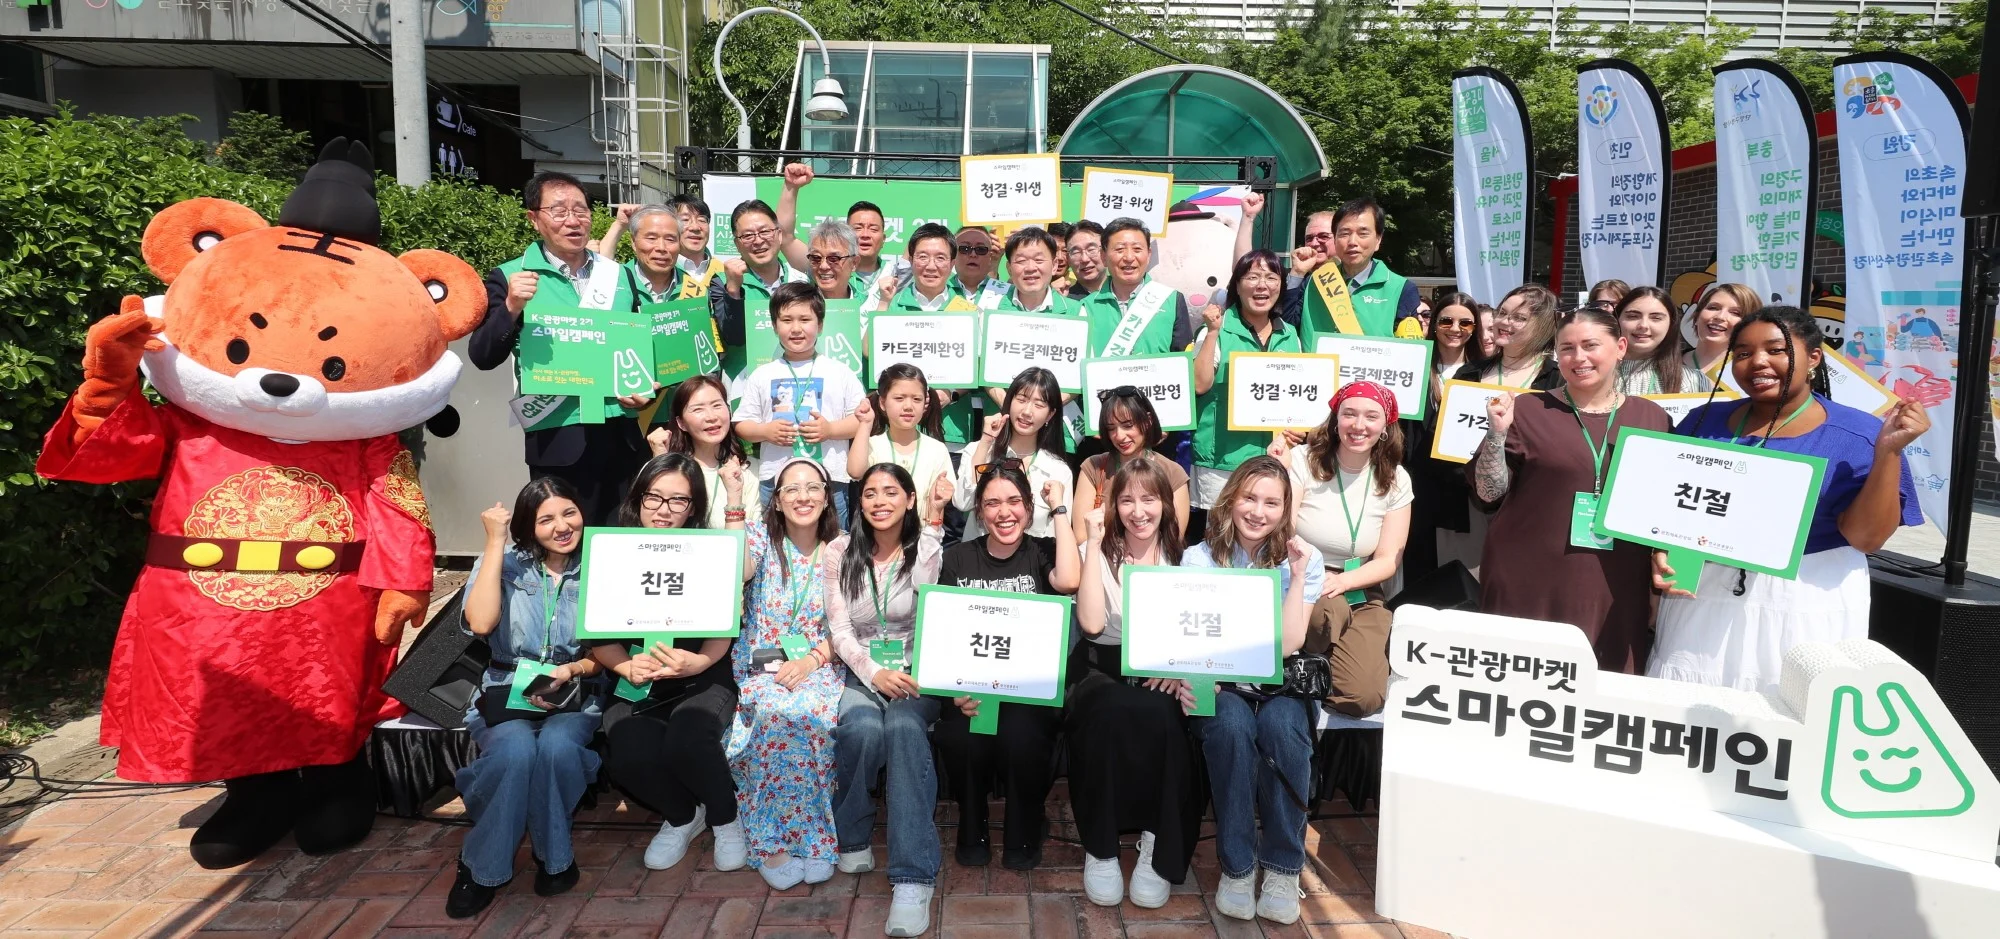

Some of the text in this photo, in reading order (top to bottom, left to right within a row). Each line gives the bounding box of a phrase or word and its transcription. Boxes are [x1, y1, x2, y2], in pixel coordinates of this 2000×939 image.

[462, 123, 477, 137] Cafe
[531, 314, 578, 326] K-관광마켓
[579, 317, 594, 327] 2기
[651, 311, 673, 322] -관광마켓
[531, 327, 606, 345] 스마일캠페인
[881, 342, 965, 359] 카드결제환영
[994, 341, 1078, 363] 카드결제환영
[1339, 365, 1413, 387] 드결제환영
[1677, 452, 1733, 470] 스마일캠페인
[1674, 482, 1731, 517] 친절
[637, 542, 682, 554] 스마일캠페인
[640, 570, 685, 597] 친절
[968, 604, 1009, 616] 스마일캠페인
[1179, 610, 1222, 638] 친절
[969, 631, 1012, 661] 친절
[1406, 639, 1578, 694] K-관광마켓
[1401, 683, 1793, 801] 스마일캠페인
